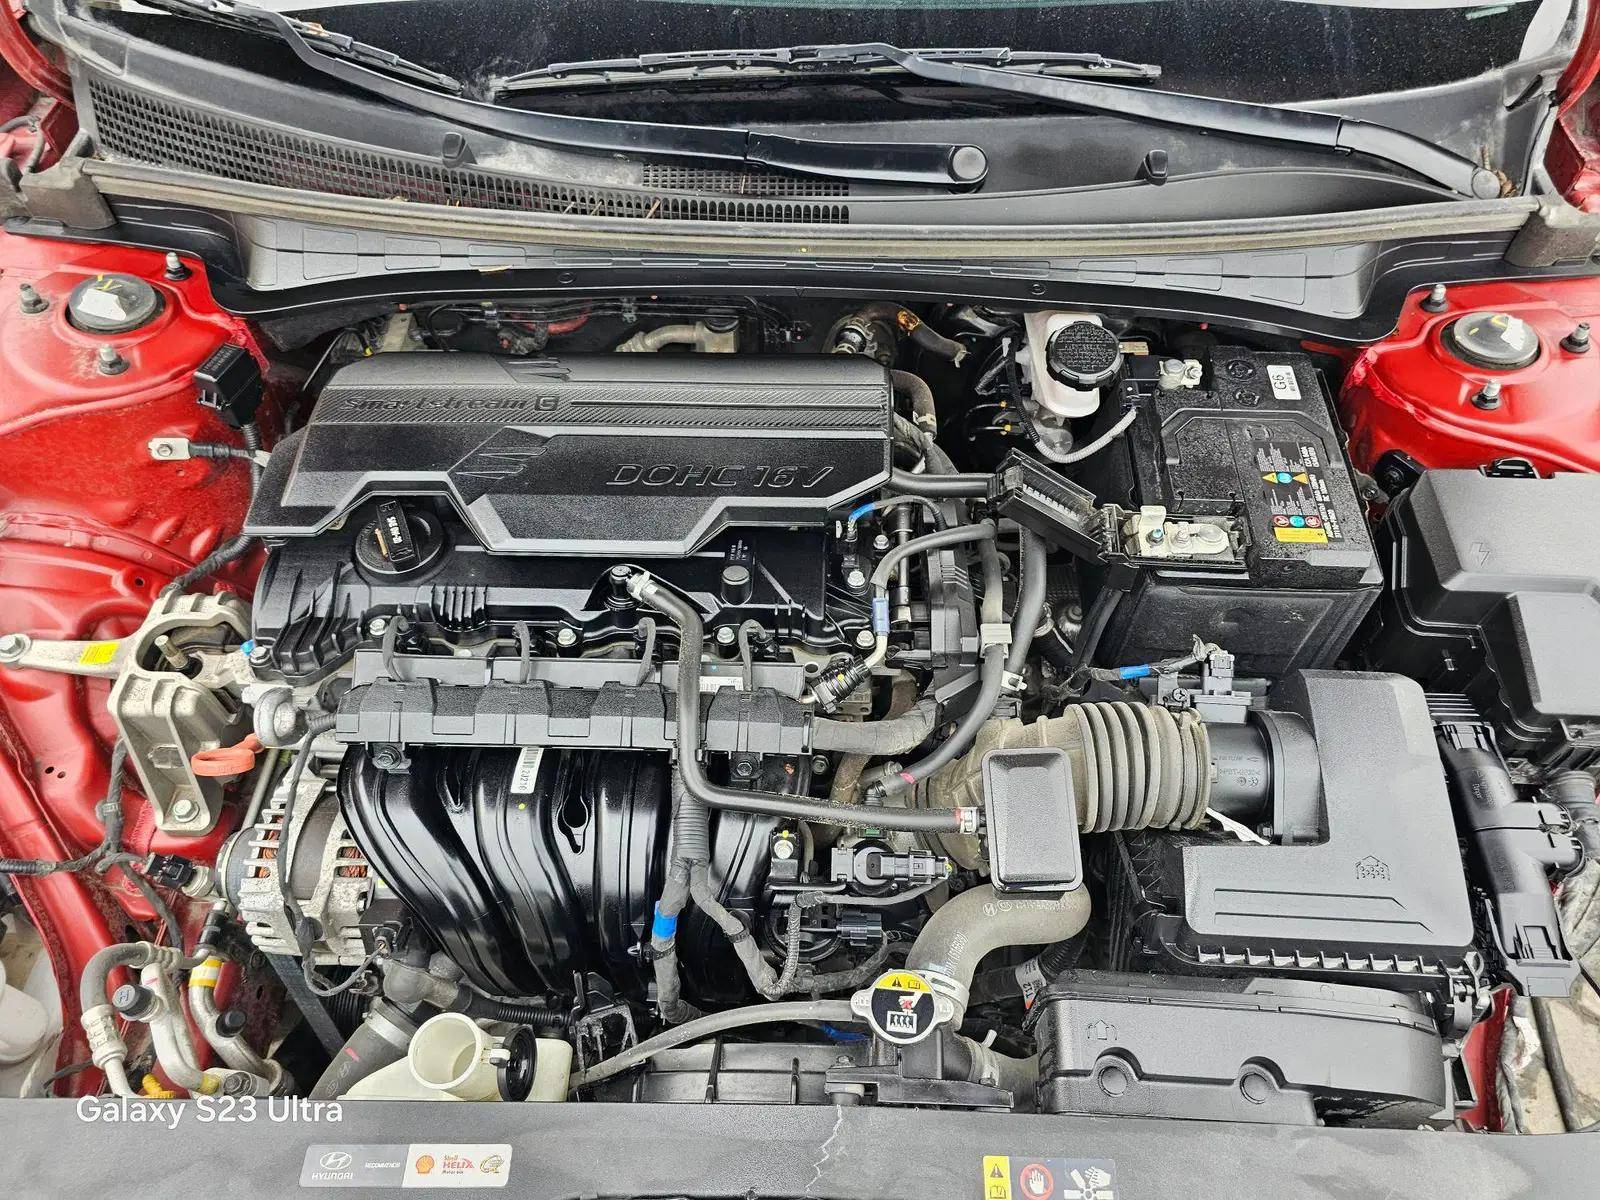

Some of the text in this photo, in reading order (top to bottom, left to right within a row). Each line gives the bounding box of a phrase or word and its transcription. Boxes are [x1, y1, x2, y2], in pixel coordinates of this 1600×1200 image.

[606, 463, 835, 488] DOHC 16V
[442, 1159, 475, 1169] HELIX
[311, 1172, 354, 1181] HYUNDAI
